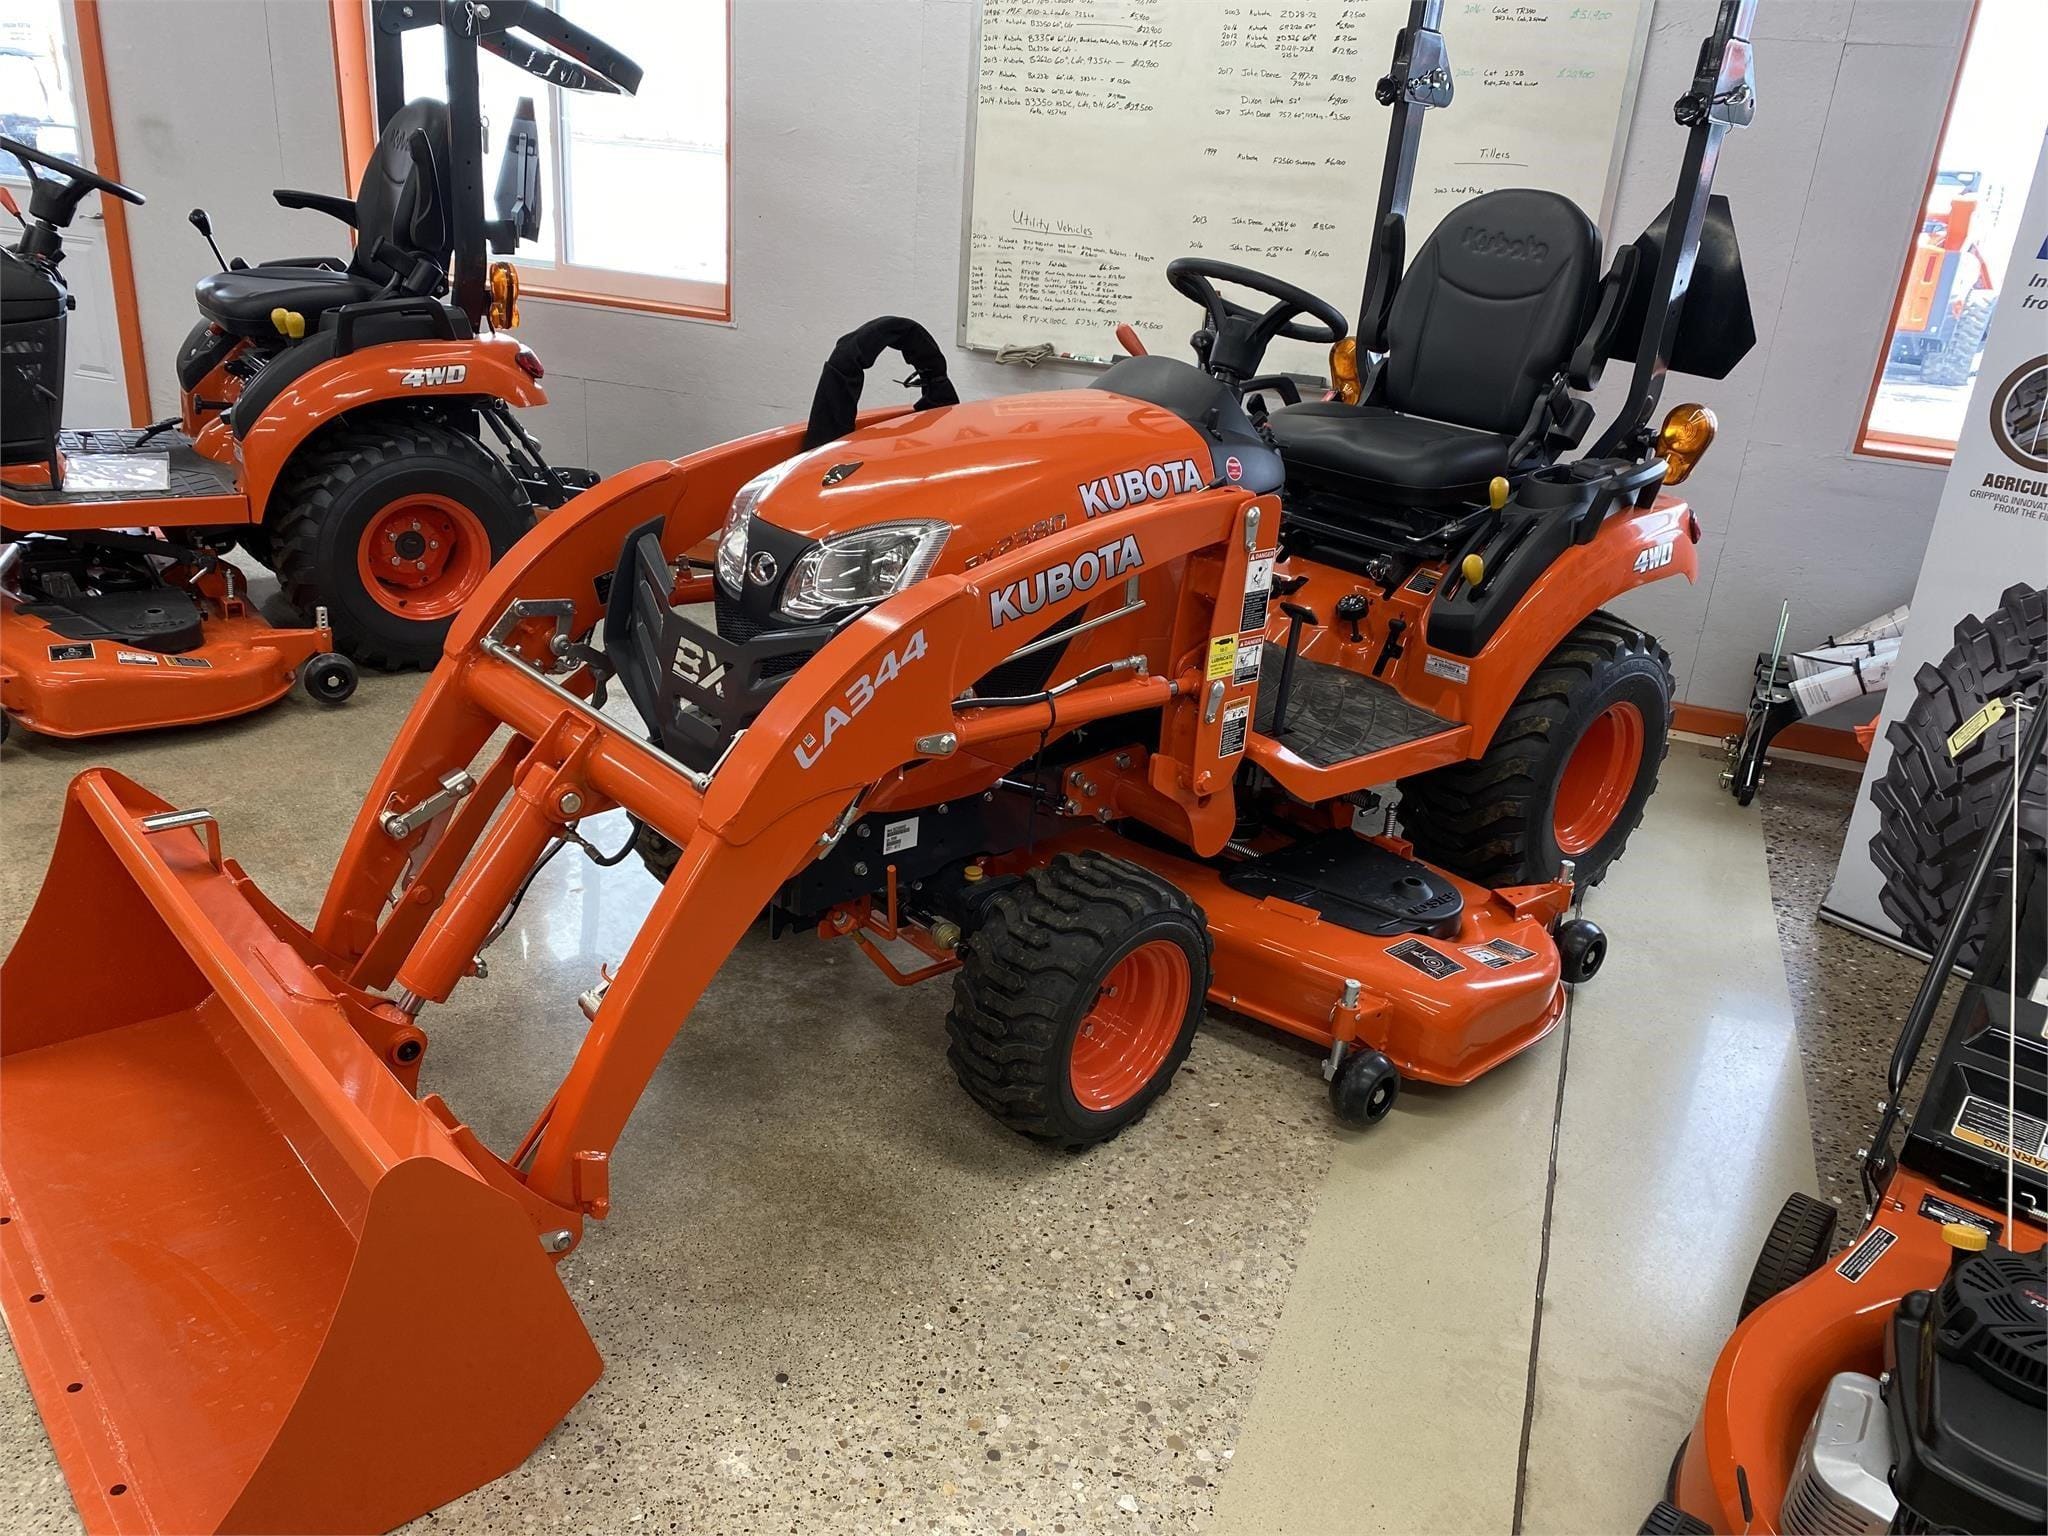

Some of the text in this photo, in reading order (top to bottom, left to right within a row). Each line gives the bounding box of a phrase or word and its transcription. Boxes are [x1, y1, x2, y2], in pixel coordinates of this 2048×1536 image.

[1241, 95, 1262, 105] Dixon
[1479, 147, 1511, 160] Tillers
[1012, 209, 1094, 237] Utility Vehicles
[400, 364, 467, 388] 4WD
[1078, 458, 1205, 519] KUBOTA
[1969, 489, 2010, 503] GRIPPING
[1994, 503, 2018, 516] FROM
[2021, 508, 2038, 518] THE
[1632, 541, 1675, 574] 4WD
[989, 533, 1144, 630] KUBOTA
[671, 636, 726, 690] BX
[793, 629, 928, 769] LA344
